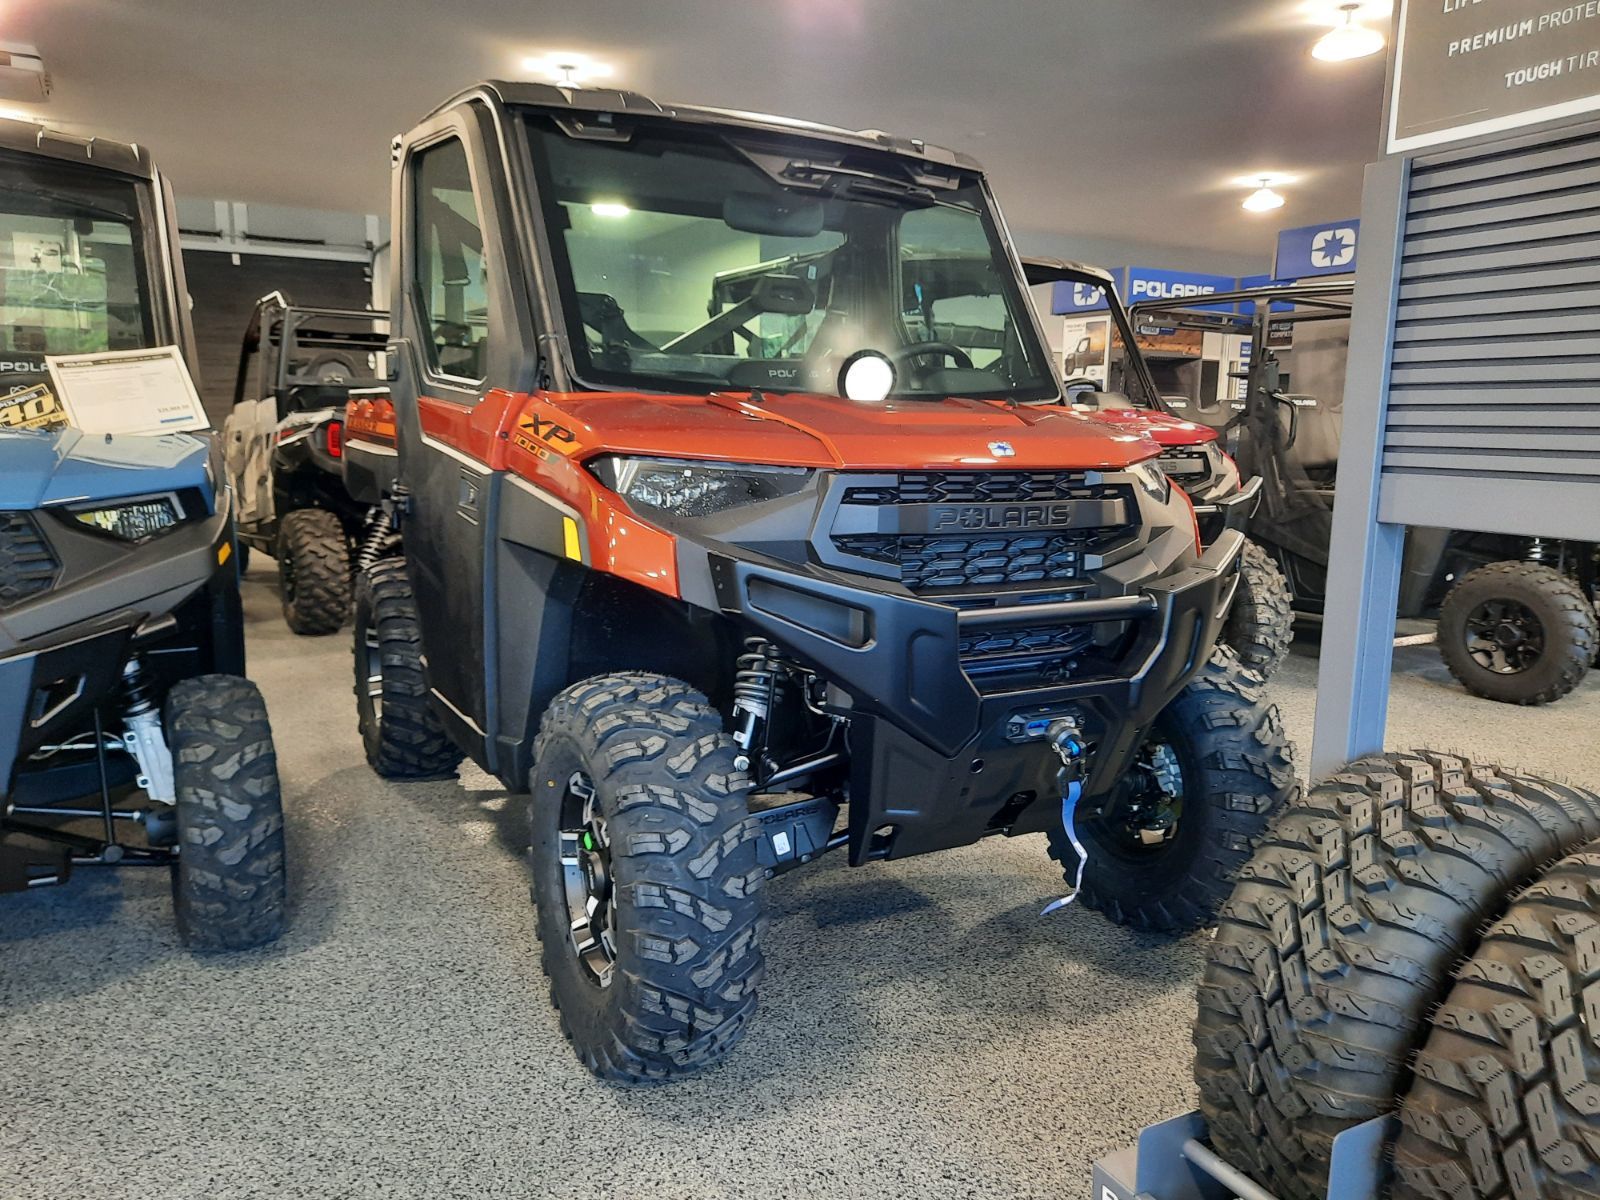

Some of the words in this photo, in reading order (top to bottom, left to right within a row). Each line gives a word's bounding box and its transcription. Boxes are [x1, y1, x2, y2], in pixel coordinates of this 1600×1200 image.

[1443, 0, 1483, 13] LI
[1448, 19, 1534, 57] PREMIUM
[1504, 60, 1563, 89] TOUGH
[1566, 50, 1599, 73] TIR
[1132, 279, 1215, 299] POLARIS
[520, 413, 576, 443] XP
[514, 434, 550, 461] 1000
[935, 505, 1071, 530] POLARIS
